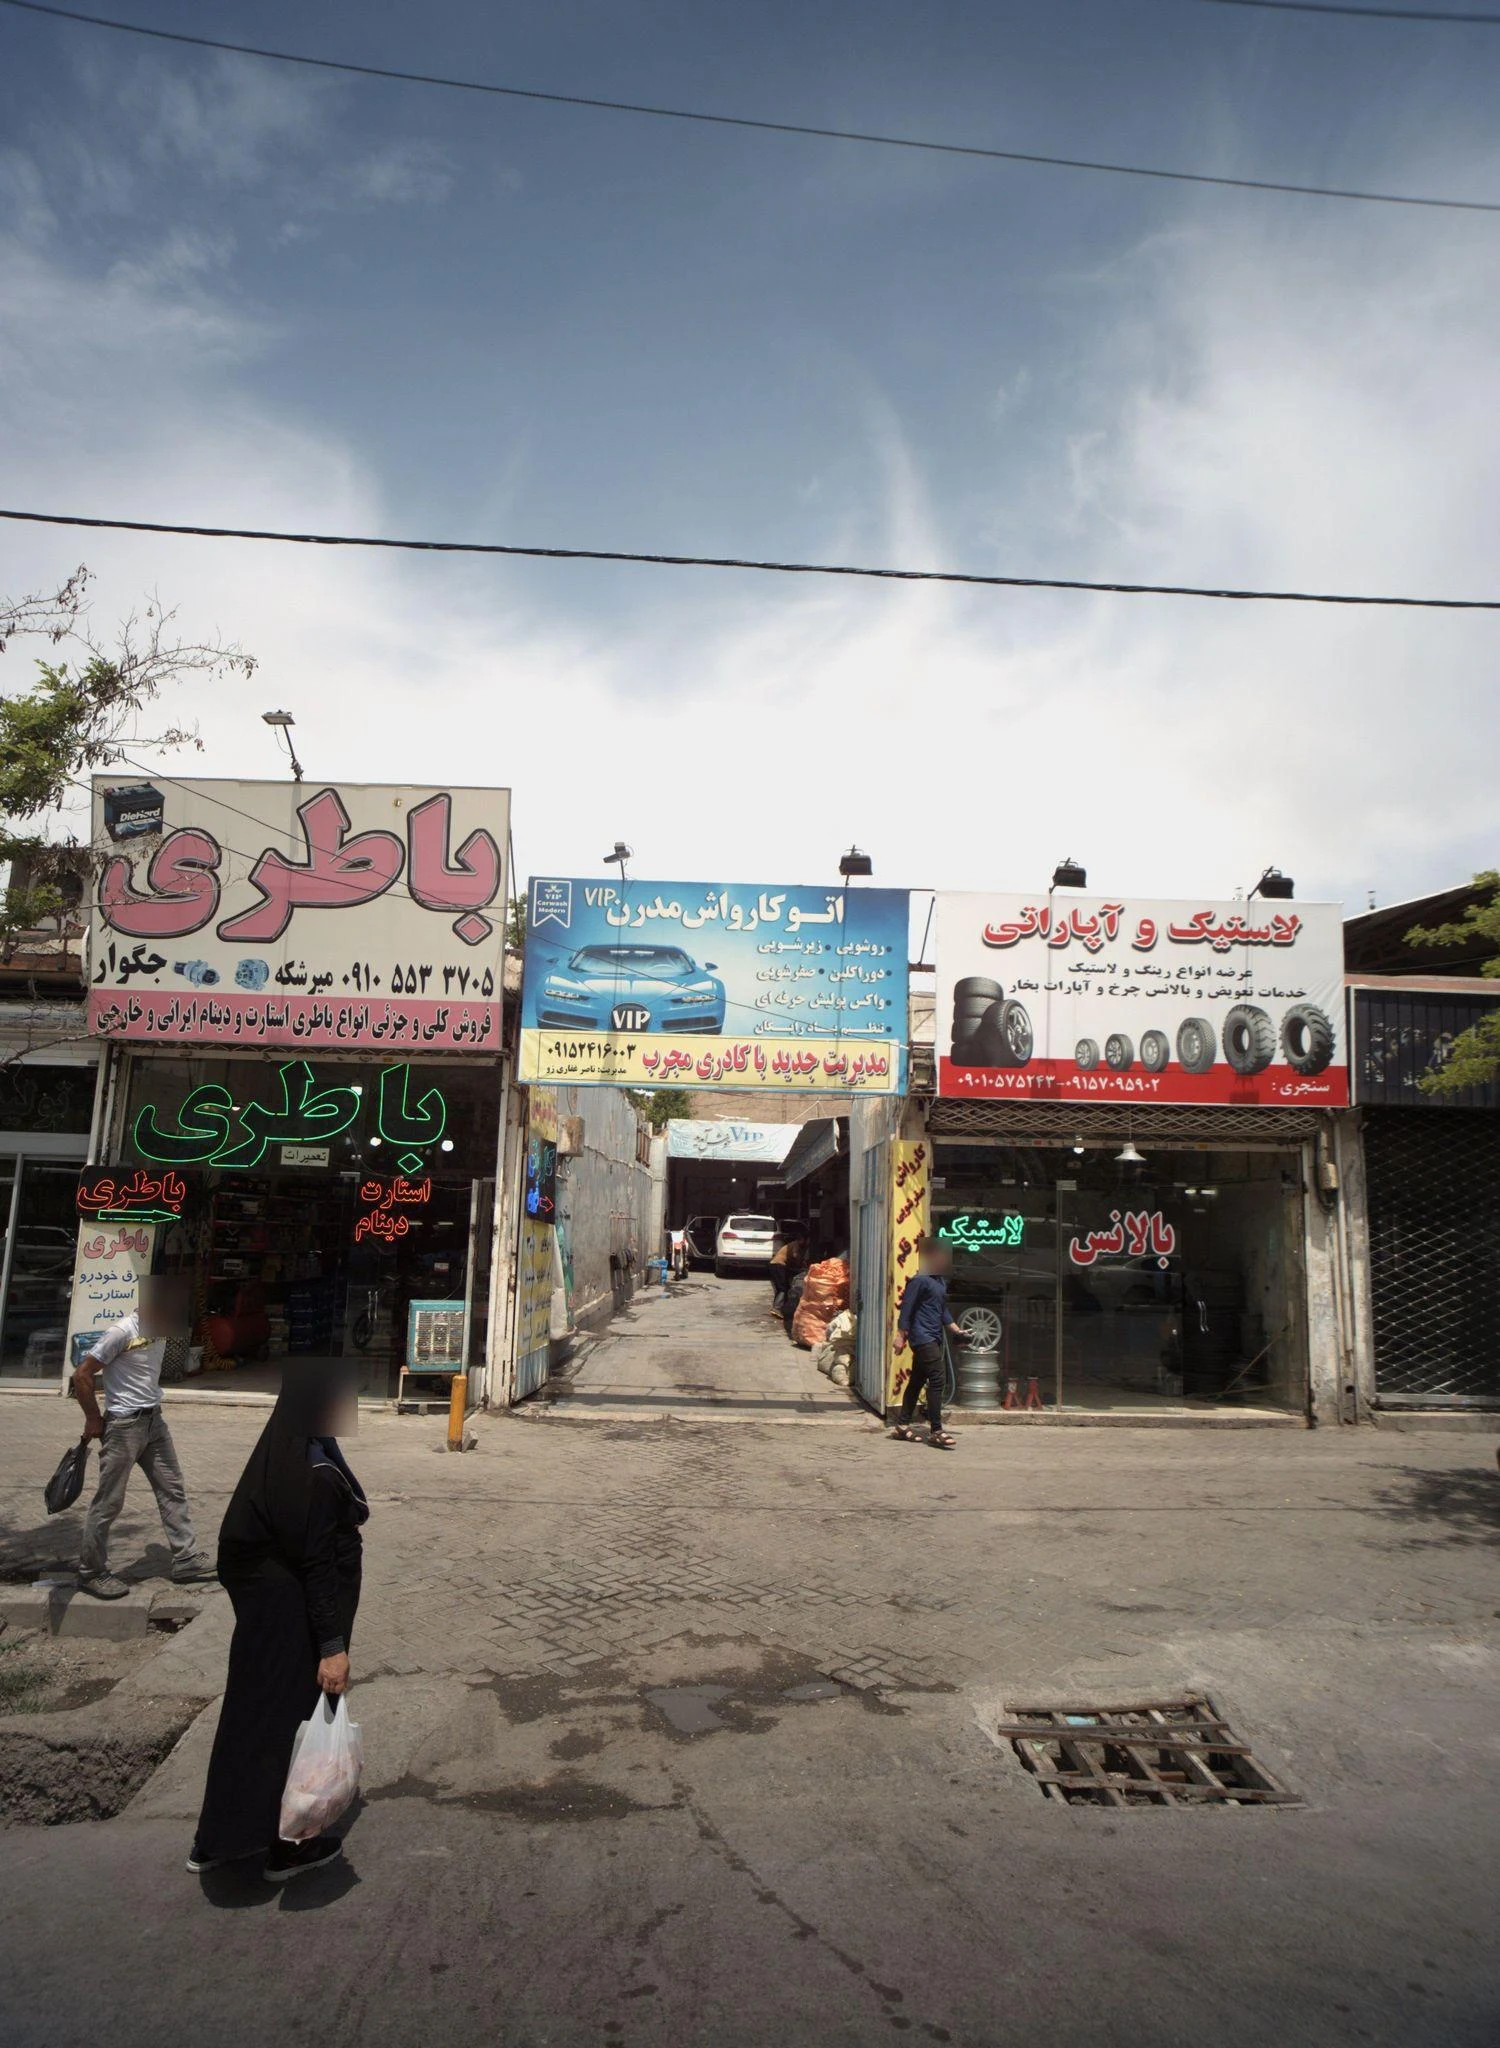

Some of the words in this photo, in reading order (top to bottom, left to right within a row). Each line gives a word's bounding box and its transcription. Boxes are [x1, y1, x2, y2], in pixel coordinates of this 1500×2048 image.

[100, 788, 499, 946] باطری
[584, 887, 616, 906] VIP
[606, 896, 682, 927] مدرن
[784, 894, 844, 932] اتو
[981, 903, 1124, 954] آپاراتی
[836, 938, 885, 955] روشویی
[1132, 916, 1158, 951] و
[1167, 911, 1302, 954] لاستیک
[92, 942, 167, 984] جگوار
[1068, 962, 1117, 976] لاستیک
[1122, 968, 1130, 978] و
[1135, 964, 1171, 979] رینگ
[1176, 965, 1212, 980] انواع
[1216, 967, 1253, 981] عرضه
[342, 962, 381, 993] ۰۹۱۰
[391, 964, 433, 994] ۵۵۳
[443, 965, 494, 997] ۳۷۰۵
[1009, 979, 1040, 993] بخار
[1097, 985, 1104, 996] و
[1109, 984, 1140, 998] چرخ
[1145, 984, 1191, 998] بالانس
[1195, 989, 1203, 999] و
[1208, 985, 1254, 1000] تعویض
[1259, 986, 1306, 999] خدمات
[97, 996, 143, 1032] خارجی
[158, 998, 197, 1032] ایرانی
[199, 1000, 231, 1032] دینام
[809, 992, 847, 1010] پولیش
[850, 993, 885, 1010] واکس
[146, 1009, 154, 1031] و
[234, 1011, 241, 1034] و
[245, 1001, 290, 1036] استارت
[292, 1003, 333, 1037] باطری
[336, 1004, 369, 1038] انواع
[372, 1004, 408, 1039] جزئی
[411, 1018, 419, 1040] و
[423, 1007, 449, 1040] کلی
[453, 1007, 492, 1042] فروش
[612, 1010, 650, 1029] VIP
[641, 1046, 692, 1077] مجرب
[695, 1044, 751, 1080] کادری
[753, 1044, 766, 1080] با
[771, 1045, 819, 1083] جدید
[823, 1050, 889, 1084] مدیریت
[134, 1061, 446, 1174] باطری
[76, 1169, 186, 1212] باطری
[361, 1177, 431, 1209] استارت
[355, 1210, 409, 1241] دینام
[938, 1214, 1024, 1252] لاستیک
[1069, 1209, 1176, 1270] بالانس
[83, 1227, 150, 1259] باطری
[80, 1272, 118, 1284] خودرو
[122, 1273, 140, 1283] رق
[89, 1289, 134, 1300] استارت
[93, 1308, 125, 1324] دینام
